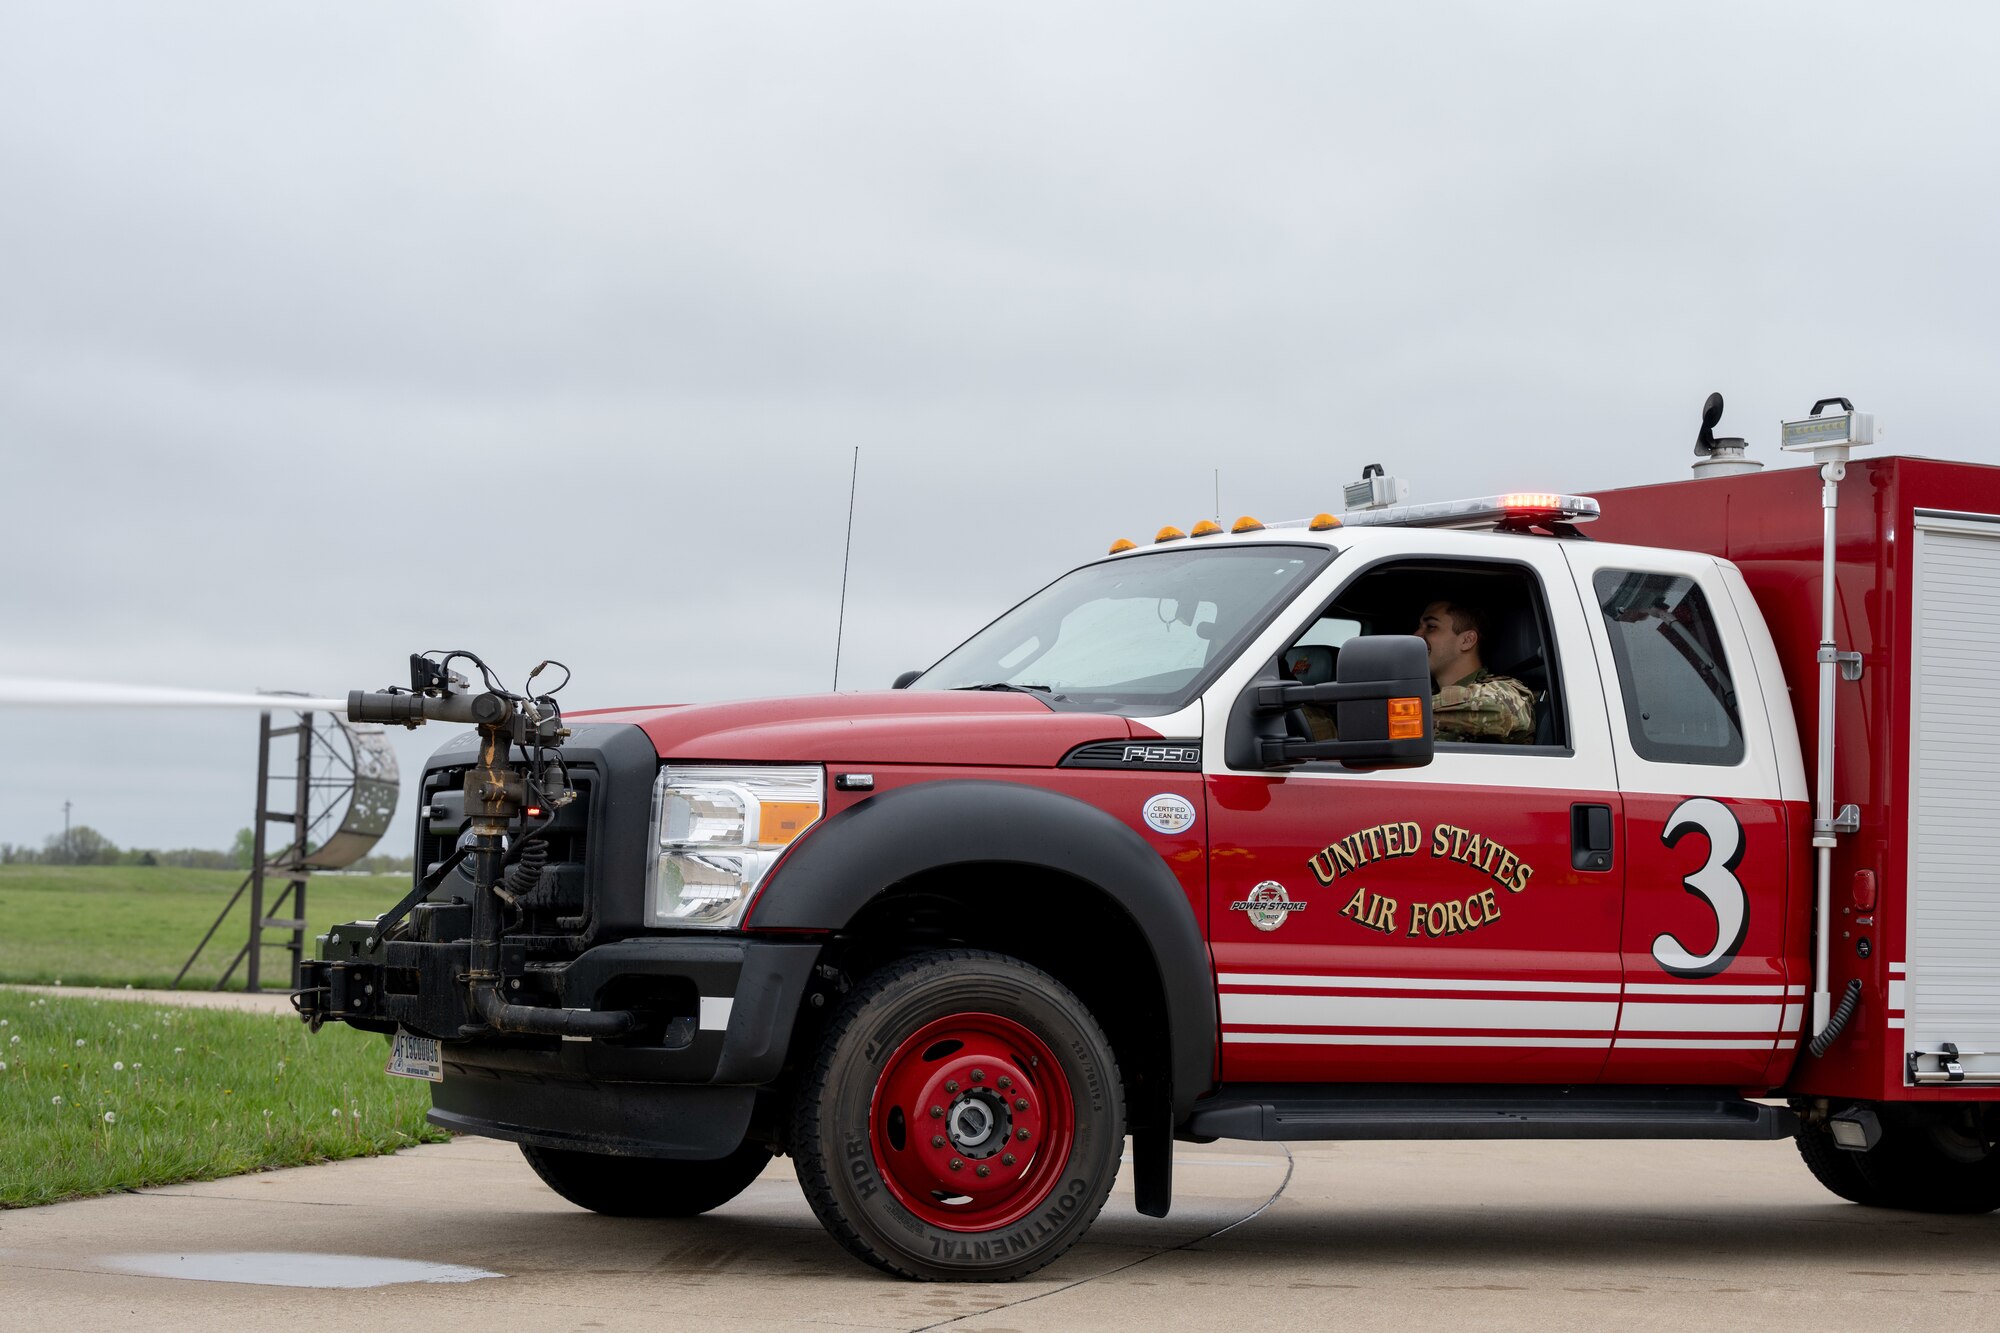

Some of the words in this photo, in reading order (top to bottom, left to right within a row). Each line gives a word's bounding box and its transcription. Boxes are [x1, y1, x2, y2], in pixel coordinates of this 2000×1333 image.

[1123, 746, 1200, 763] F-550
[1152, 805, 1186, 813] CERTIFIED
[1308, 821, 1422, 887] UNITED
[1431, 823, 1534, 893] STATES
[1230, 901, 1268, 911] POWER
[1268, 901, 1307, 911] STROKE
[1339, 887, 1397, 934] AIR
[1406, 888, 1500, 937] FORCE
[1651, 796, 1750, 979] 3
[929, 1178, 1087, 1260] CONTINENTAL
